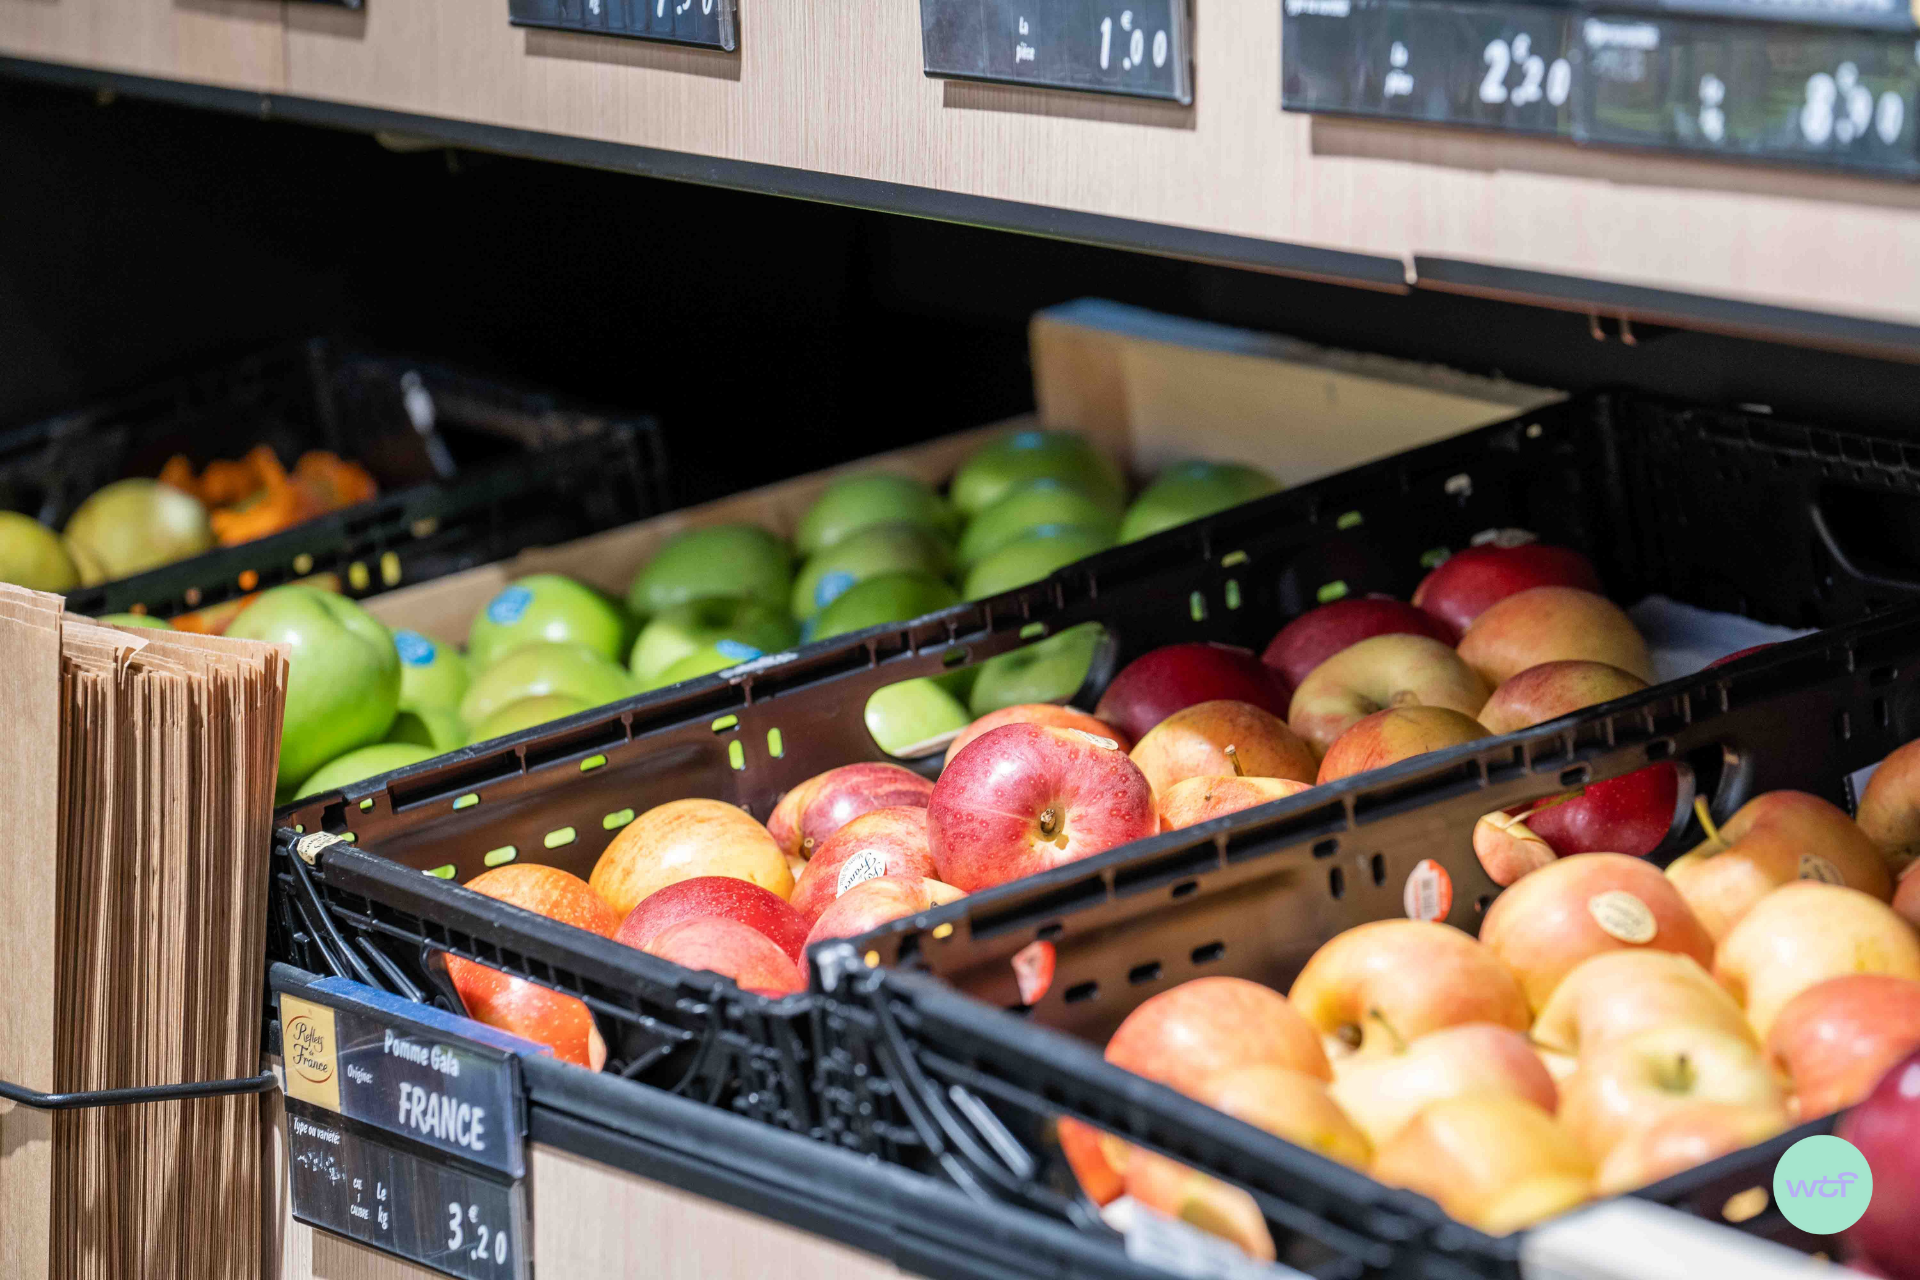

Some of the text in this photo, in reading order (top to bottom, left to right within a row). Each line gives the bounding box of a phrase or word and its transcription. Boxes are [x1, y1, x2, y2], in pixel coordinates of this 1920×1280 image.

[293, 1043, 328, 1073] France
[383, 1028, 460, 1077] Pomme Gala
[294, 1116, 307, 1135] Type
[308, 1125, 317, 1137] ou
[398, 1081, 486, 1151] FRANCE
[377, 1204, 388, 1230] kg
